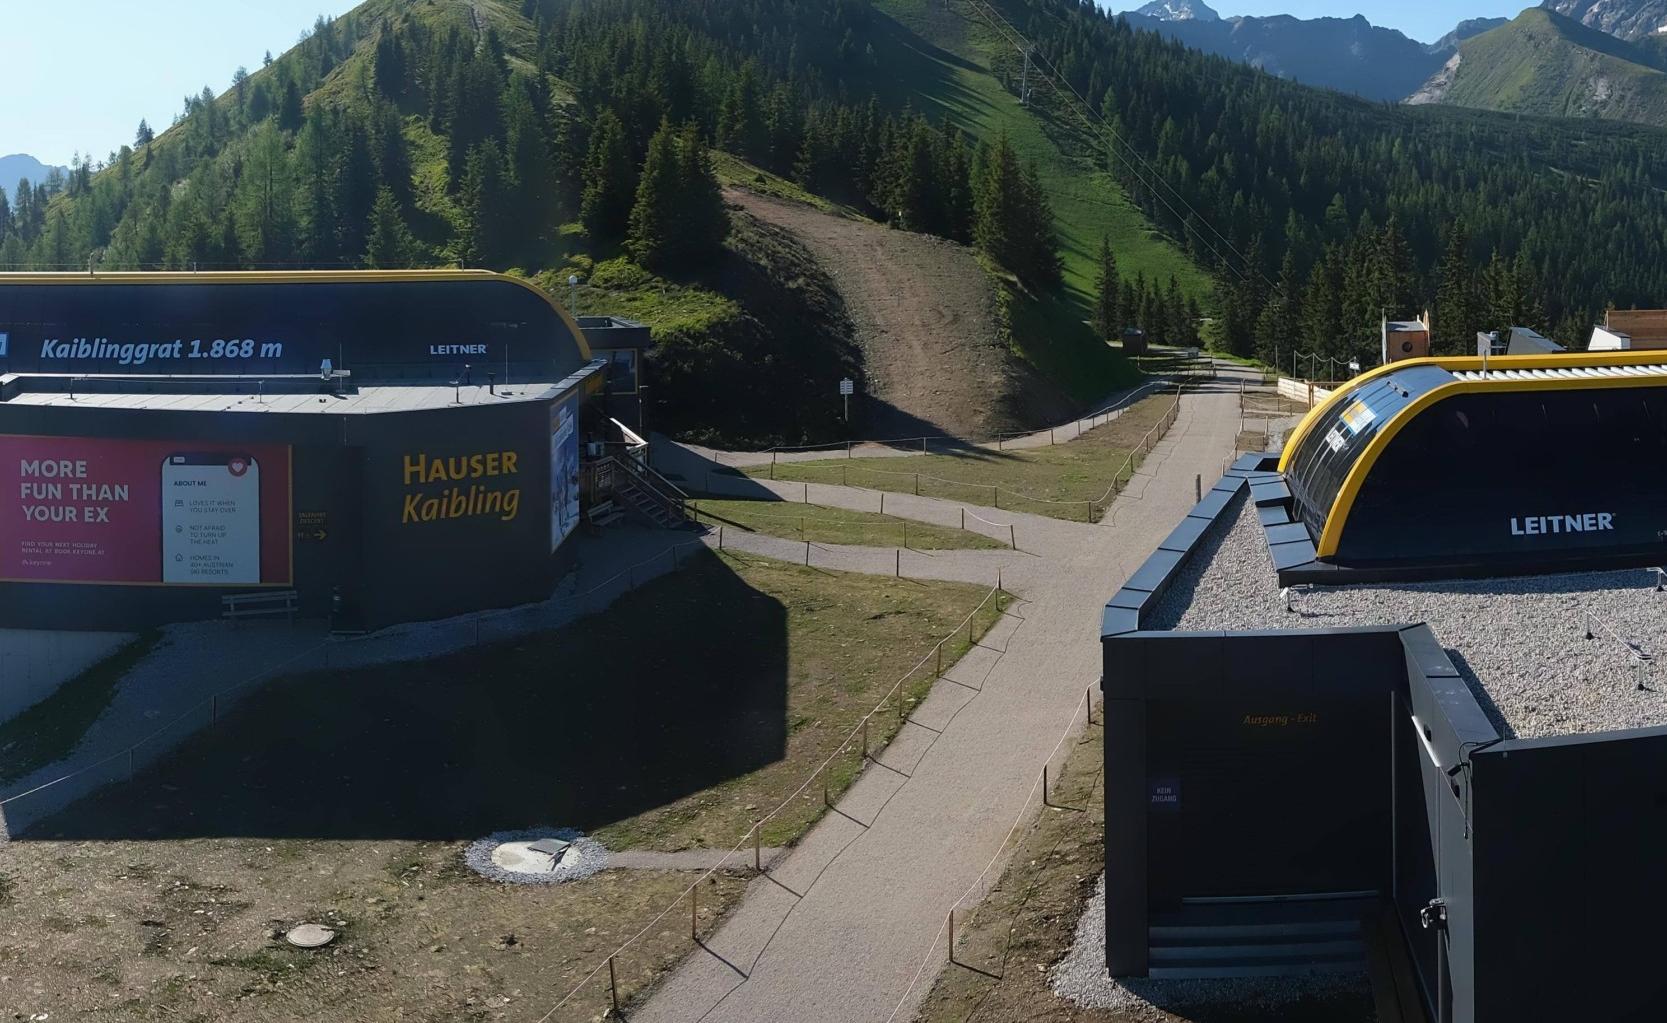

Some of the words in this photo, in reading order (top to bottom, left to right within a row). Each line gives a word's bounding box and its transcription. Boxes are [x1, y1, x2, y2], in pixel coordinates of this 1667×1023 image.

[40, 338, 183, 364] Kaiblinggrat
[188, 339, 254, 358] 1.868
[260, 342, 283, 358] m
[430, 344, 487, 355] LEITNER
[20, 459, 87, 478] MORE
[403, 451, 518, 485] HAUSER
[20, 482, 62, 499] FUN
[69, 483, 129, 501] THAN
[22, 505, 77, 522] YOUR
[84, 506, 109, 522] EX
[402, 485, 520, 523] Kaibling
[1510, 512, 1614, 535] LEITNER
[1243, 714, 1288, 727] Ausgang
[1297, 713, 1317, 723] Exit
